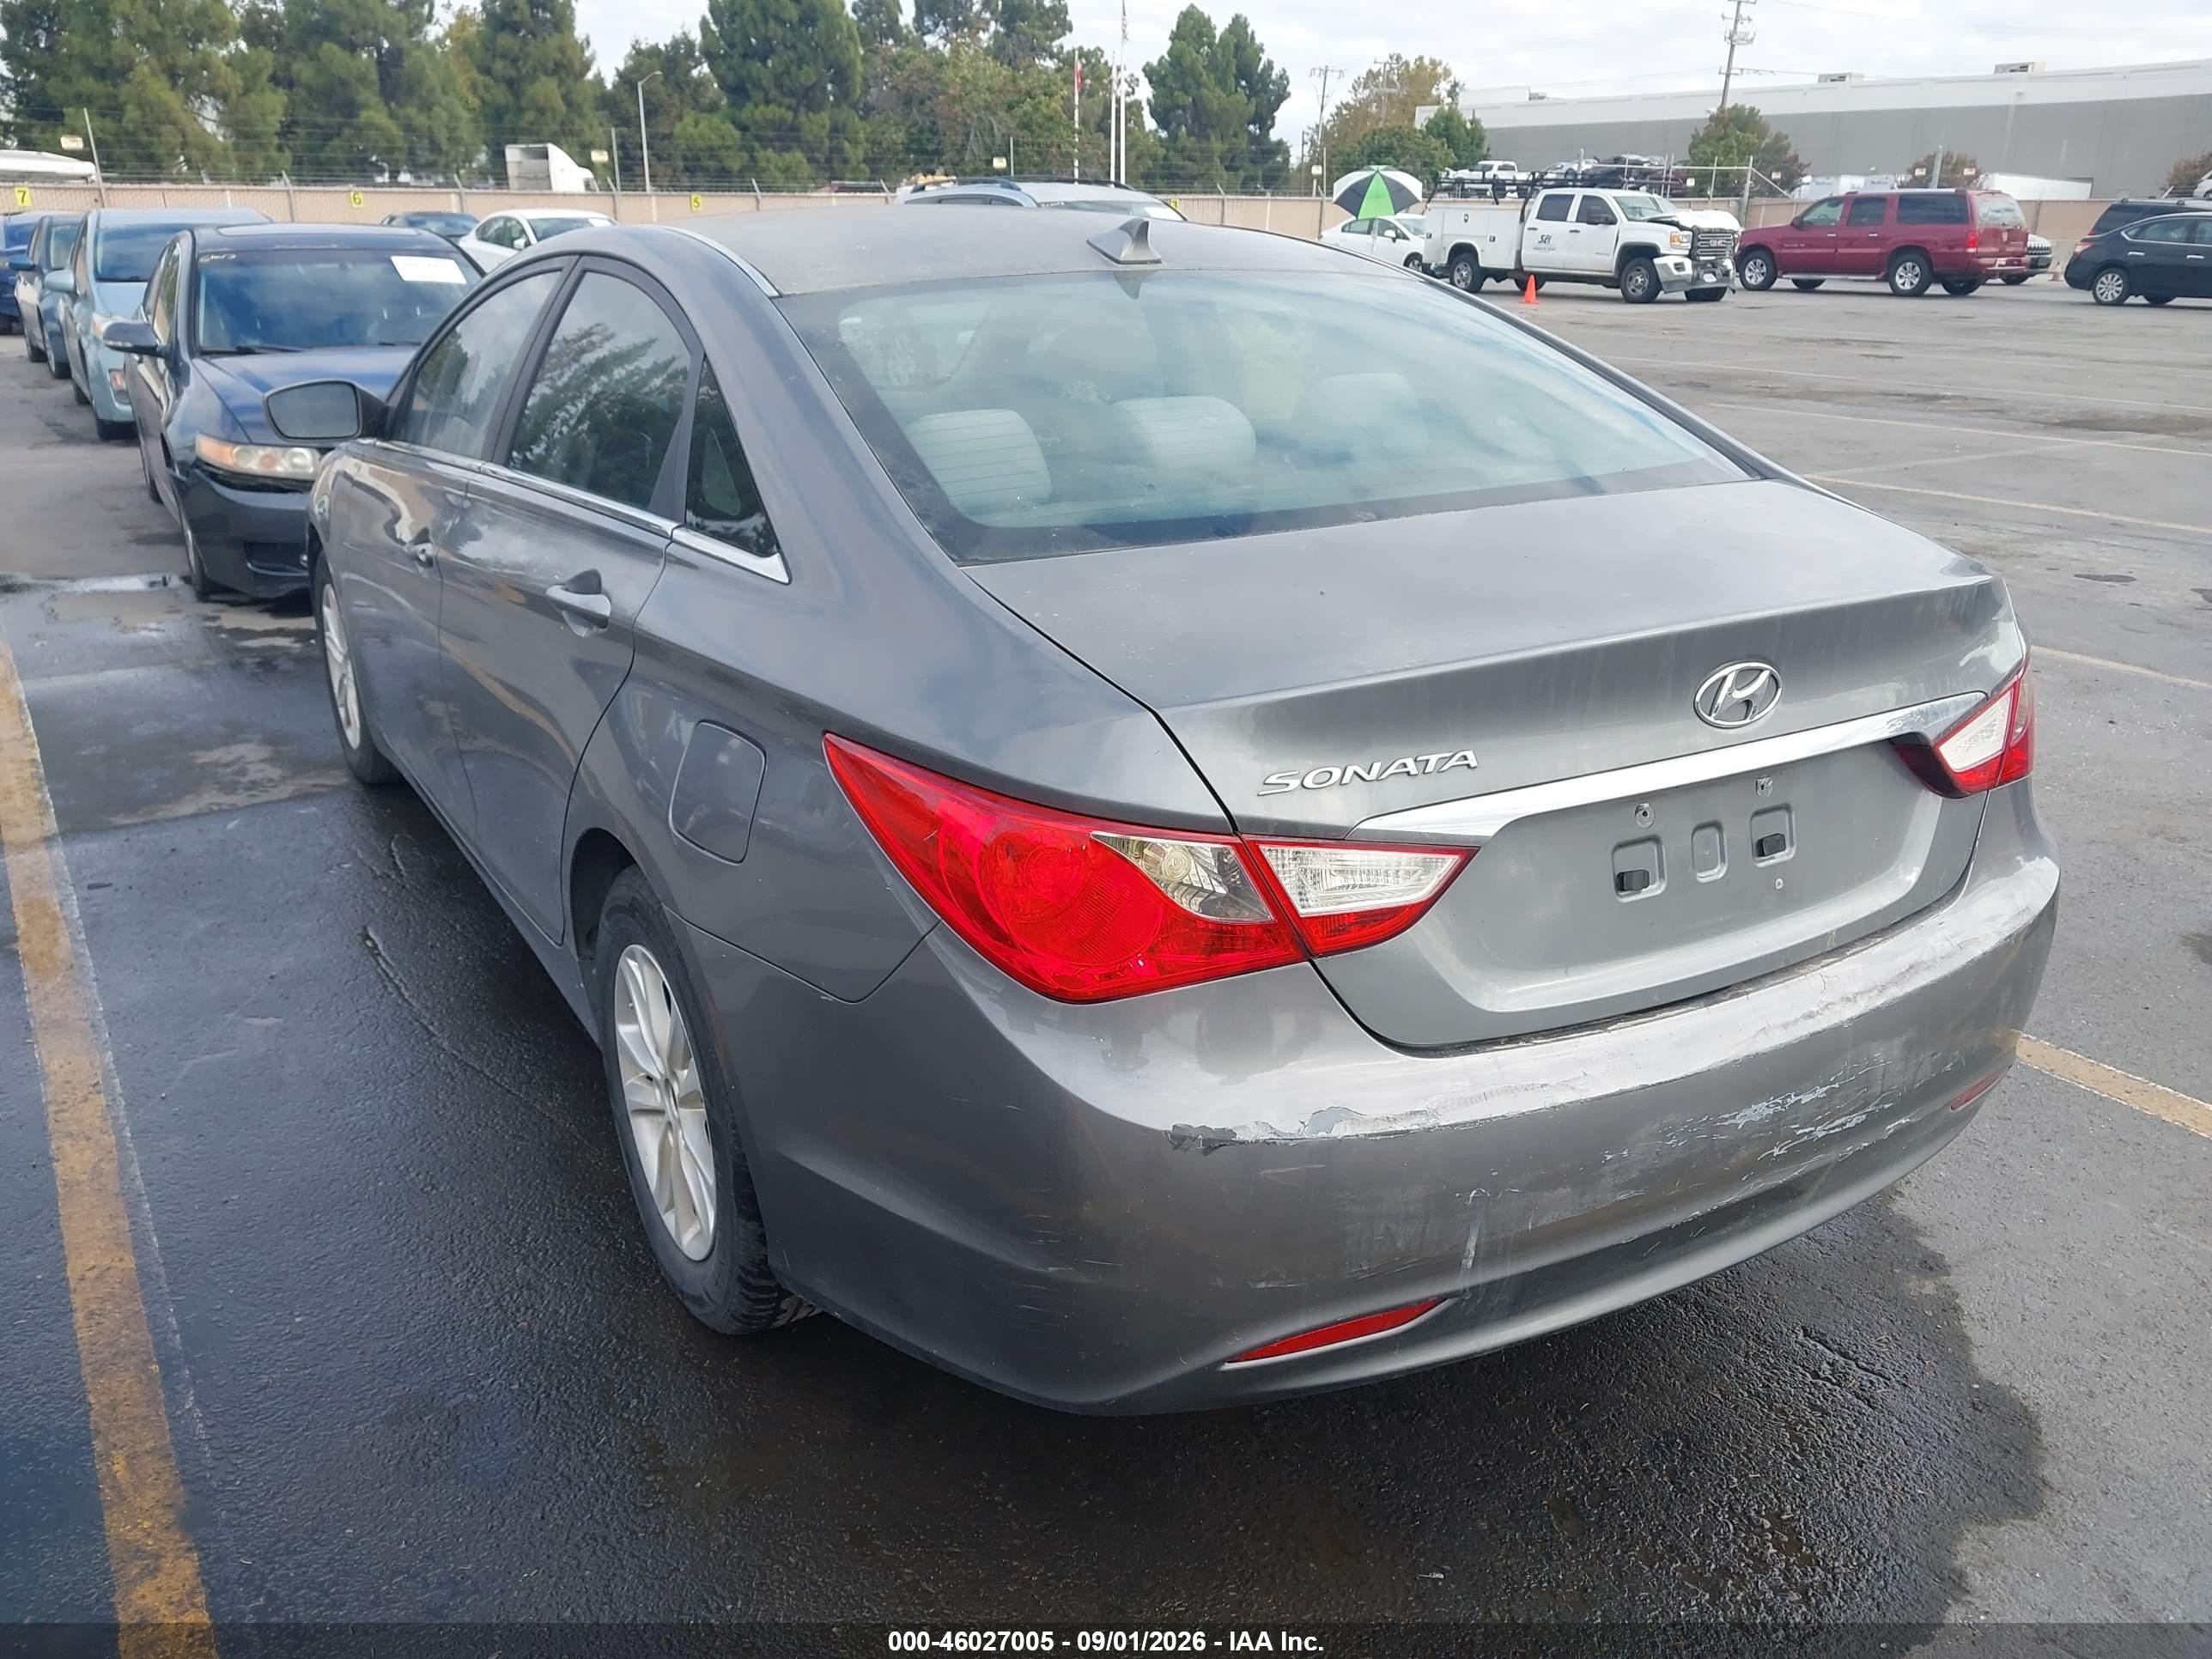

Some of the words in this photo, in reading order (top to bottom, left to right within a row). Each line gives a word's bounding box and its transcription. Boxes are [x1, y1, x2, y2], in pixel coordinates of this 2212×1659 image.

[16, 189, 27, 204] 7
[353, 191, 362, 205] 6
[693, 196, 701, 208] 5
[1257, 749, 1479, 797] SONATA
